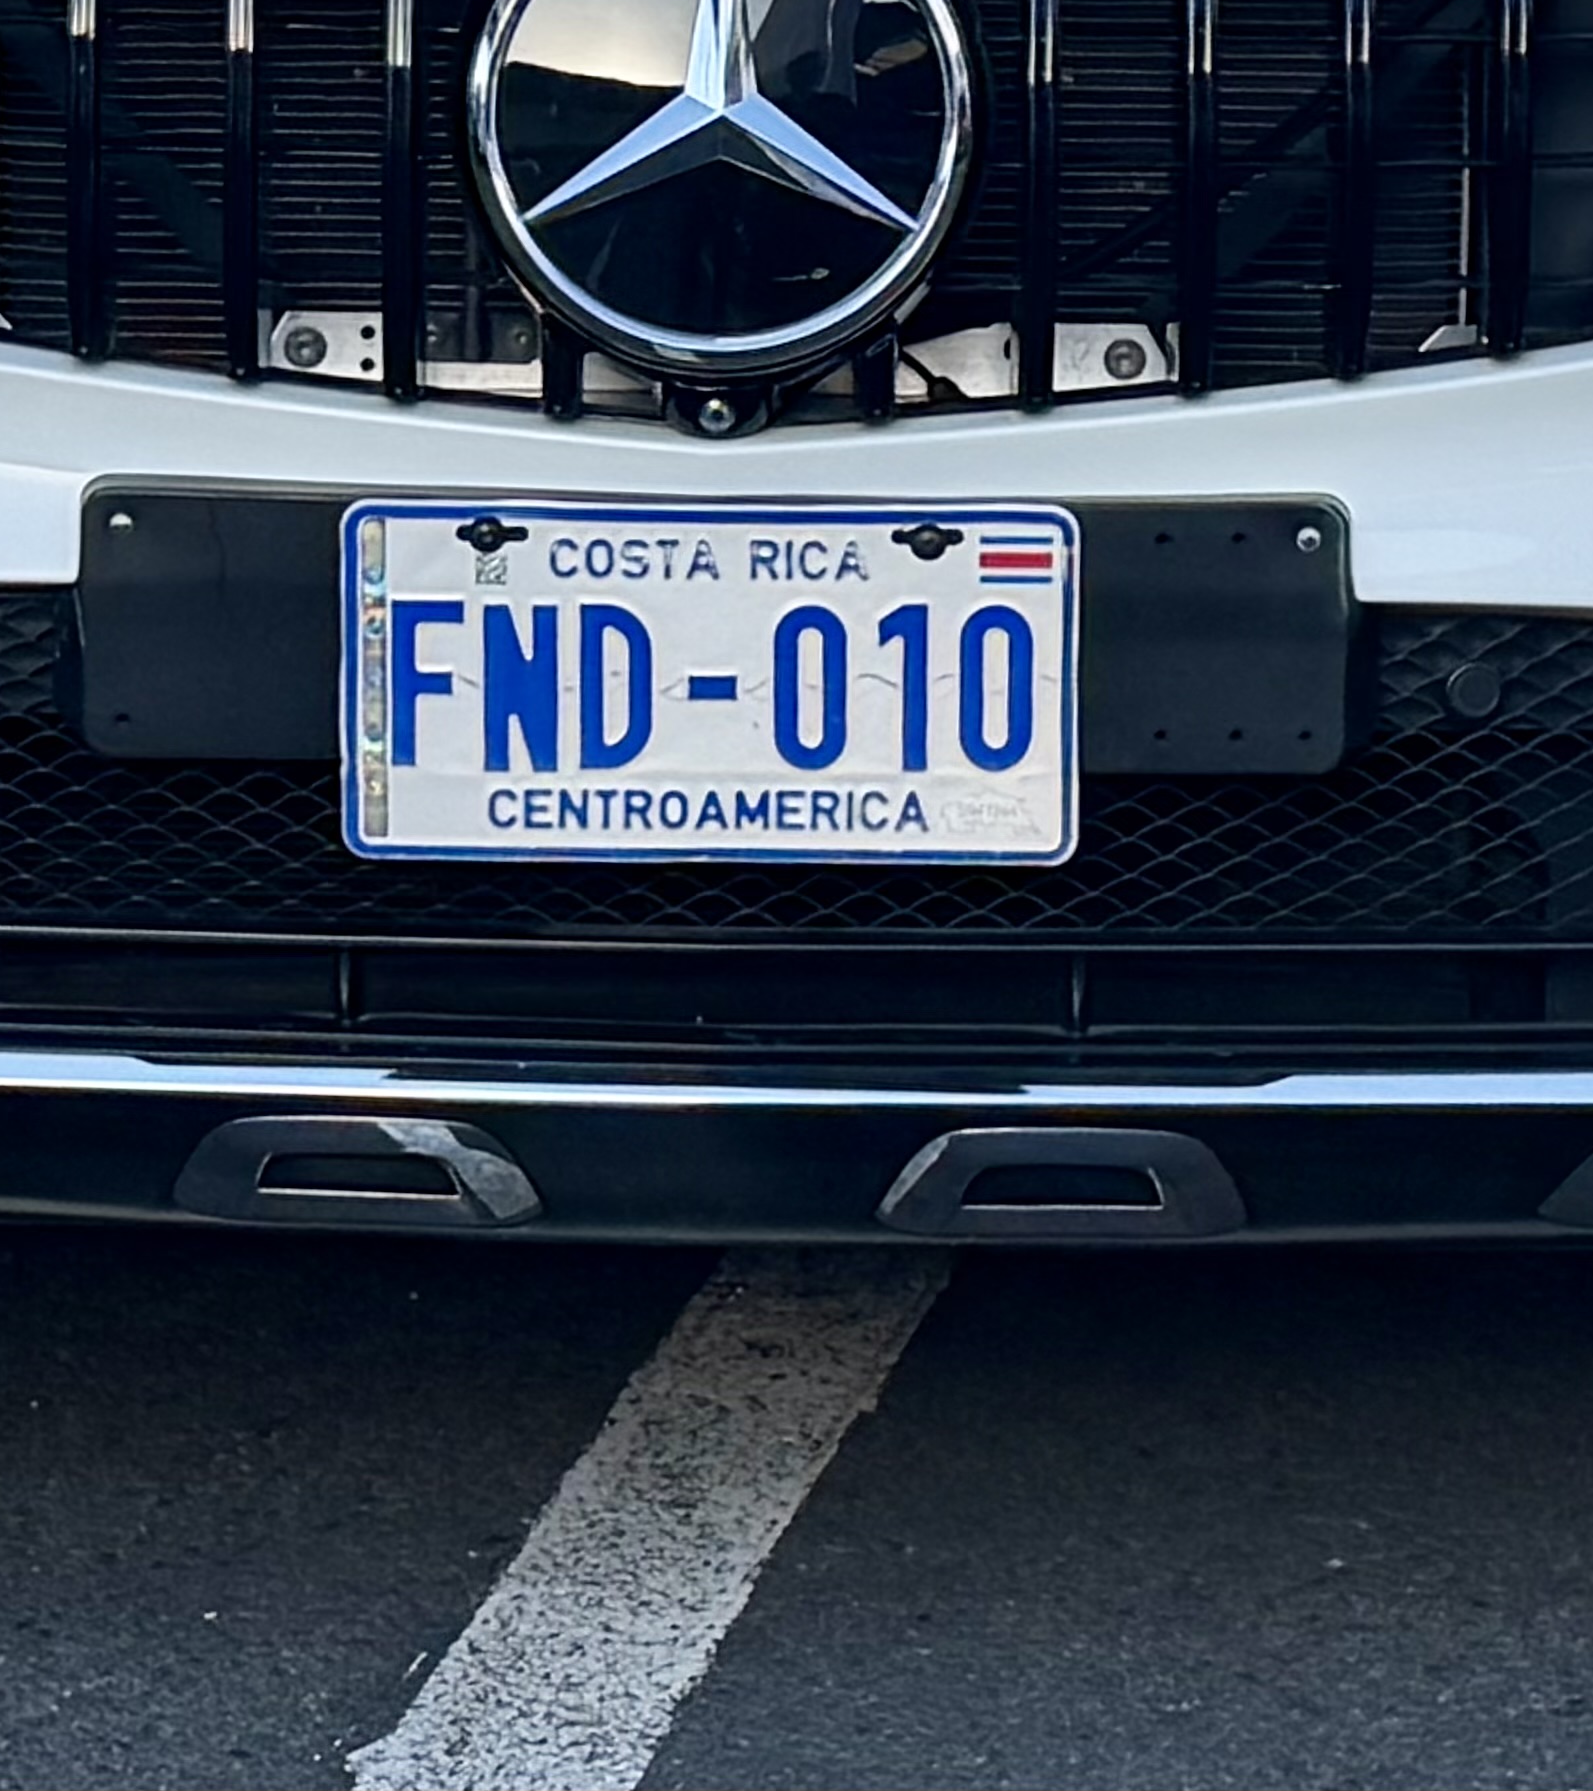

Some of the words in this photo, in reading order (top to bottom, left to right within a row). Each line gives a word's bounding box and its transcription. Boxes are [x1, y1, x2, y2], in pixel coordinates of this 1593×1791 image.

[548, 538, 719, 581] COSTA
[749, 539, 870, 583] RICA
[390, 600, 1035, 773] FND-010
[488, 790, 930, 833] CENTROAMERICA
